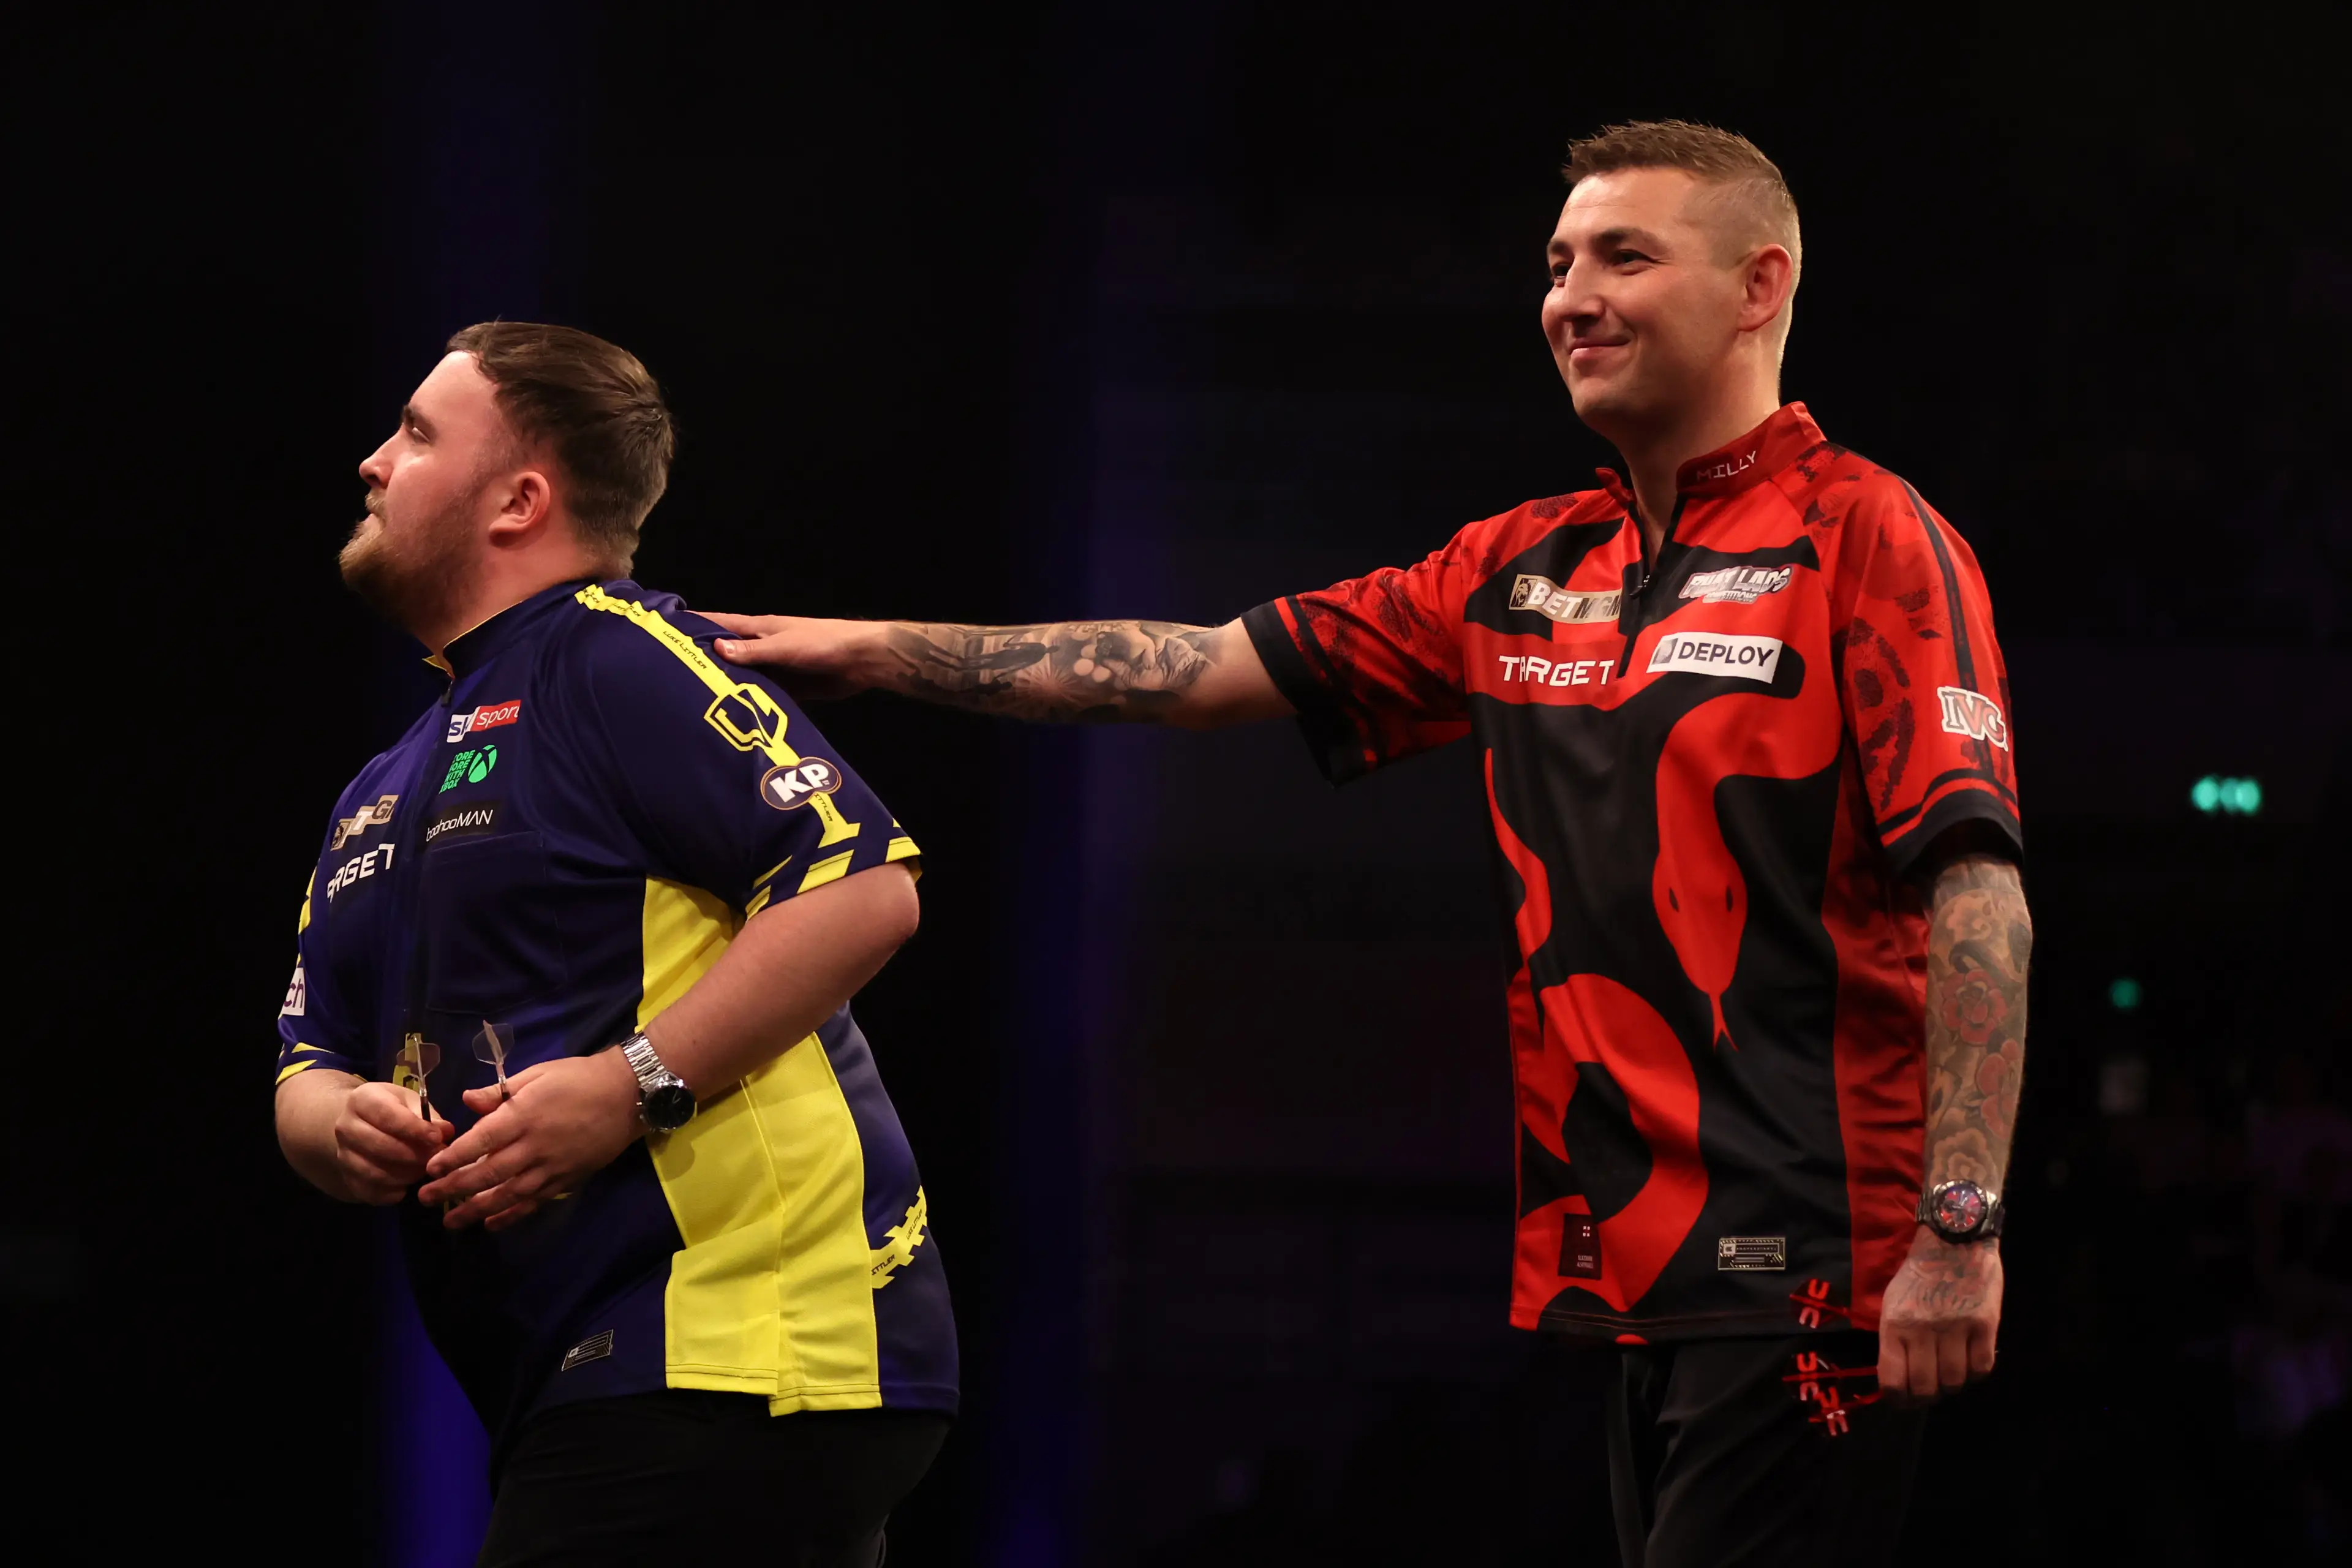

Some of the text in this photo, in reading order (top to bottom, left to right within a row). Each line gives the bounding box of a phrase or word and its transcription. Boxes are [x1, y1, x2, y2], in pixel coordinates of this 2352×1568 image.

[1697, 450, 1756, 481] MILLY
[1733, 568, 1791, 594] LADS
[663, 631, 707, 669] LUKE LITTLER
[1678, 641, 1774, 667] DEPLOY
[1499, 655, 1615, 686] TARGET
[448, 706, 520, 736] sk sport
[449, 760, 471, 772] ORE
[453, 749, 476, 764] ORE
[769, 763, 829, 803] KP
[813, 793, 833, 821] ITTLER
[426, 809, 494, 842] boohooMAN
[327, 843, 395, 903] ARGET
[871, 1254, 895, 1275] ITTLER
